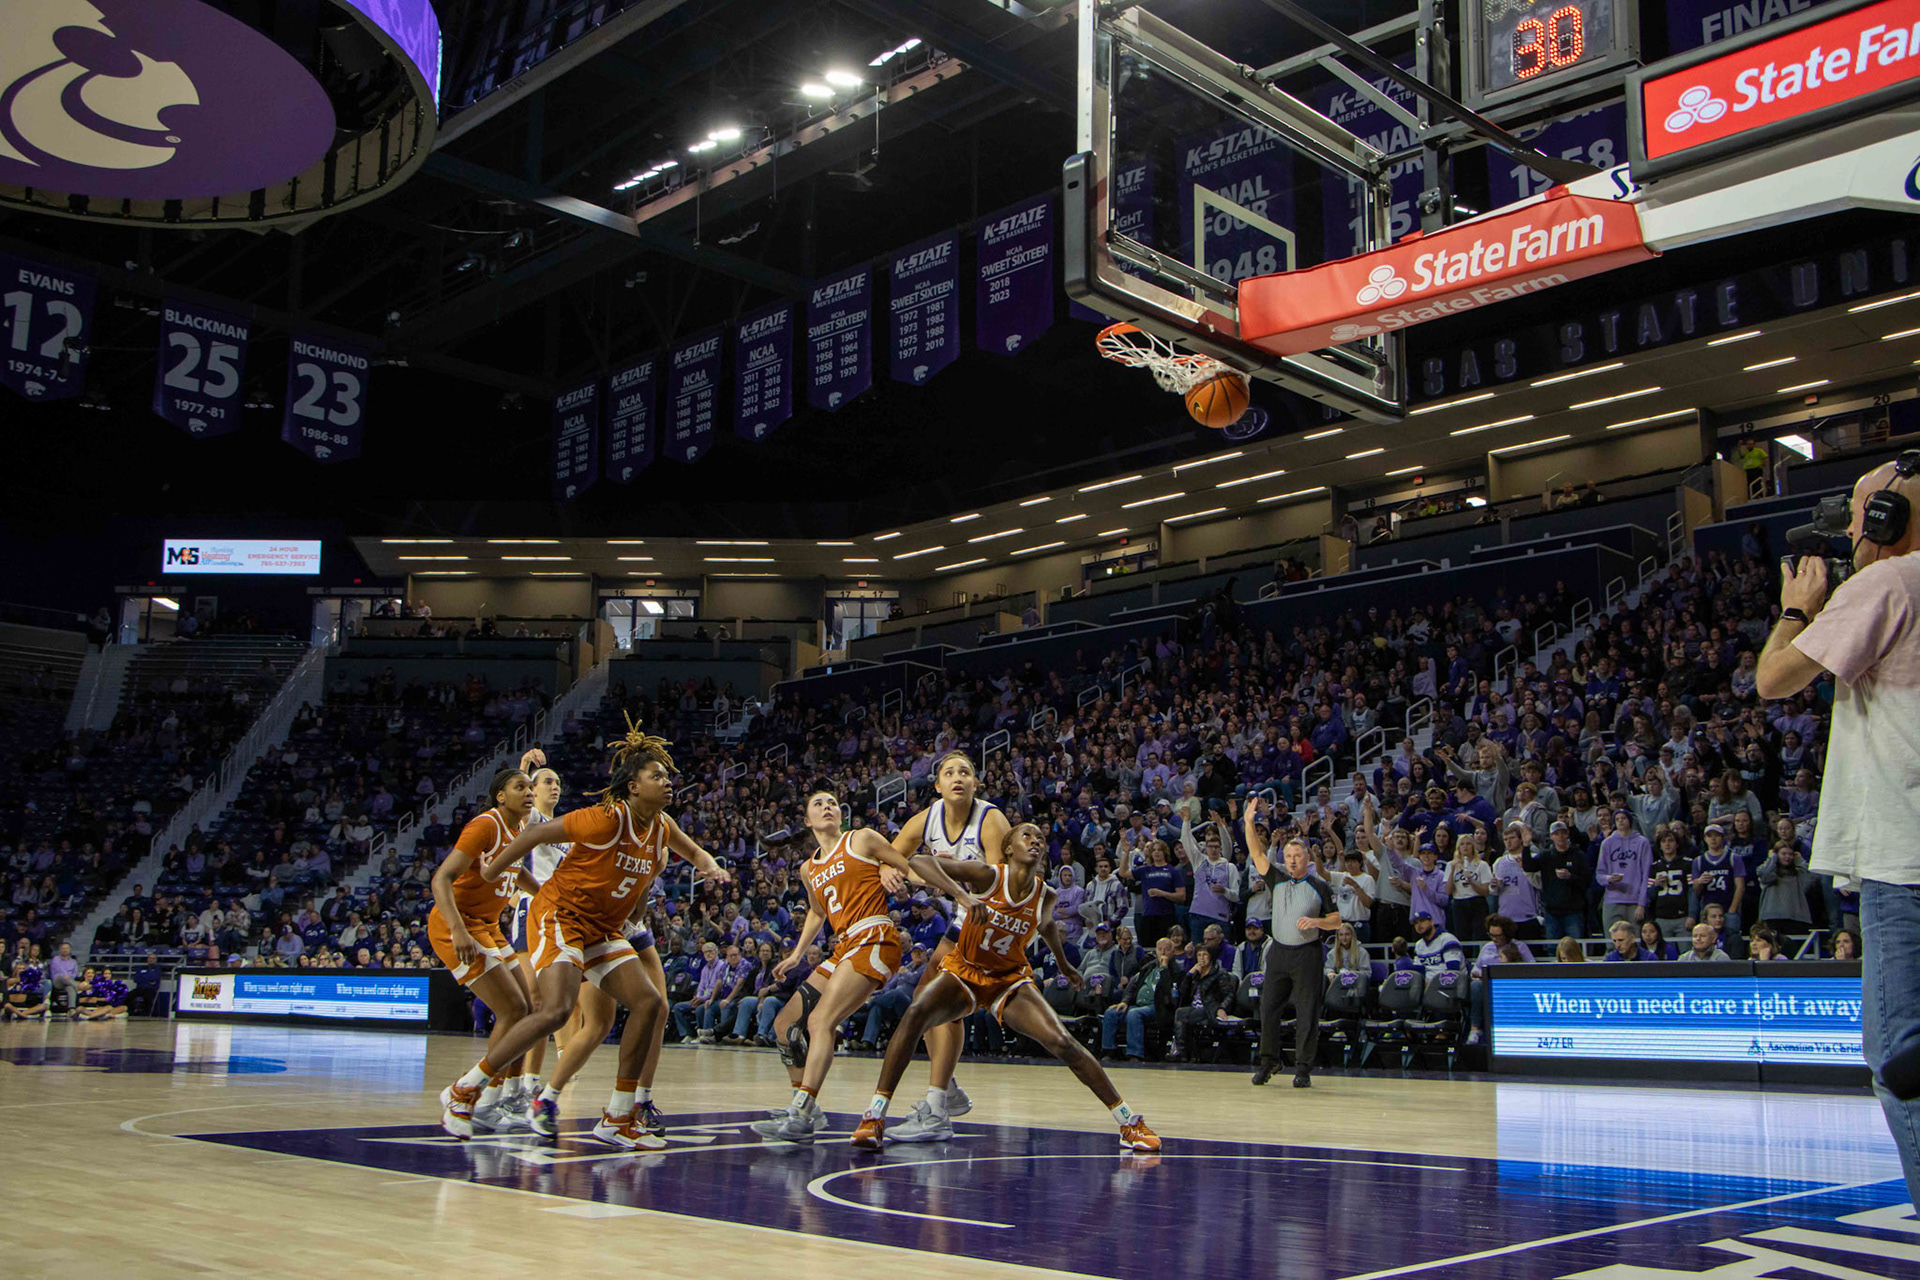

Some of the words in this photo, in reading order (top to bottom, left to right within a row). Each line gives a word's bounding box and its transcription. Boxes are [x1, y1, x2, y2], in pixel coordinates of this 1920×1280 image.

[1515, 5, 1583, 79] 30
[1732, 46, 1851, 113] State
[1336, 108, 1366, 124] MEN'S
[1360, 125, 1422, 157] NAL
[1191, 162, 1219, 177] MEN'S
[1219, 141, 1276, 167] BASKETBALL
[983, 203, 1047, 241] K-STATE
[1006, 220, 1042, 241] BASKETBALL
[1116, 210, 1143, 228] IGHT
[895, 240, 953, 275] K-STATE
[981, 257, 1012, 278] SWEET
[1011, 243, 1049, 267] SIXTEEN
[1005, 245, 1023, 257] NCAA
[1411, 239, 1506, 291] State
[1508, 213, 1605, 268] Farm
[915, 257, 947, 274] BASKETBALL
[18, 268, 76, 296] EVANS
[812, 272, 867, 304] K-STATE
[914, 280, 931, 291] NCAA
[989, 277, 1010, 292] 2018
[891, 292, 919, 311] SWEET
[919, 278, 954, 299] SIXTEEN
[989, 289, 1010, 304] 2023
[1376, 296, 1473, 329] State
[1469, 273, 1571, 300] Farm
[808, 320, 835, 338] SWEET
[835, 309, 867, 328] SIXTEEN
[831, 310, 846, 320] NCAA
[899, 310, 918, 324] 1972
[926, 300, 945, 314] 1981
[3, 290, 83, 365] 12
[164, 308, 247, 340] BLACKMAN
[740, 309, 788, 339] K-STATE
[899, 322, 918, 336] 1973
[925, 312, 945, 327] 1982
[816, 339, 833, 351] 1951
[841, 330, 858, 343] 1961
[899, 334, 918, 348] 1975
[925, 325, 945, 339] 1988
[1423, 338, 1517, 396] SAS
[1560, 281, 1739, 363] STATE
[293, 340, 368, 370] RICHMOND
[674, 337, 720, 365] K-STATE
[749, 343, 775, 362] NCAA
[815, 350, 833, 363] 1956
[840, 341, 858, 355] 1964
[899, 346, 918, 360] 1977
[925, 337, 944, 352] 2010
[164, 332, 240, 399] 25
[611, 362, 653, 388] K-STATE
[744, 372, 759, 384] 2011
[765, 364, 781, 376] 2017
[815, 362, 833, 375] 1958
[840, 353, 858, 367] 1968
[683, 369, 706, 386] NCAA
[743, 383, 759, 395] 2012
[764, 375, 781, 388] 2018
[814, 373, 832, 387] 1959
[840, 365, 857, 379] 1970
[292, 363, 361, 427] 23
[556, 384, 596, 409] K-STATE
[620, 393, 642, 409] NCAA
[742, 394, 758, 407] 2013
[764, 386, 780, 399] 2019
[1873, 394, 1890, 406] 20
[174, 399, 226, 419] 1977-81
[742, 405, 758, 418] 2014
[763, 398, 780, 410] 2023
[564, 413, 585, 430] NCAA
[1739, 423, 1754, 433] 19
[301, 426, 349, 446] 1986-88
[615, 851, 653, 875] TEXAS
[1610, 848, 1637, 862] Cats
[495, 871, 518, 898] 35
[611, 876, 638, 899] 5
[811, 860, 846, 892] TEXAS
[1503, 875, 1519, 886] 24
[1707, 876, 1727, 892] 24
[823, 885, 843, 914] 2
[980, 928, 1015, 956] 14
[1533, 991, 1591, 1014] When
[1595, 998, 1632, 1019] you
[1637, 992, 1686, 1014] need
[1690, 998, 1737, 1014] care
[1742, 993, 1800, 1021] right
[1803, 998, 1863, 1022] away
[1537, 1037, 1560, 1049] 24/7
[1562, 1037, 1574, 1049] ER
